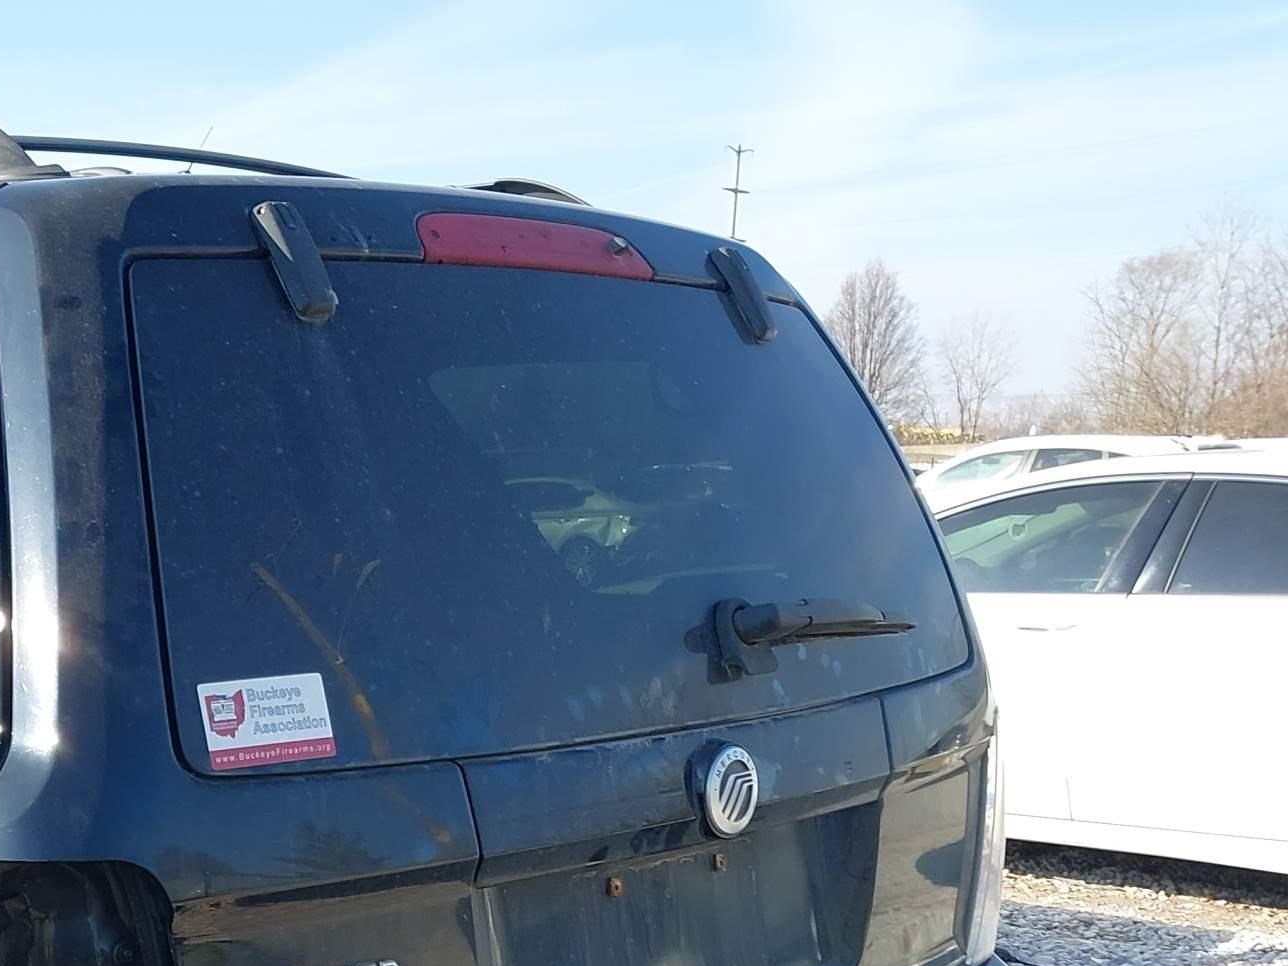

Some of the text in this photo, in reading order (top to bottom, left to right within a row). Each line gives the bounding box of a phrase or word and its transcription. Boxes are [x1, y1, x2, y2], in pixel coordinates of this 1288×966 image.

[246, 686, 301, 702] Buckeye
[249, 703, 305, 718] Firearms
[253, 716, 327, 735] Association
[215, 742, 331, 764] www.BuckeyeFirearms.org
